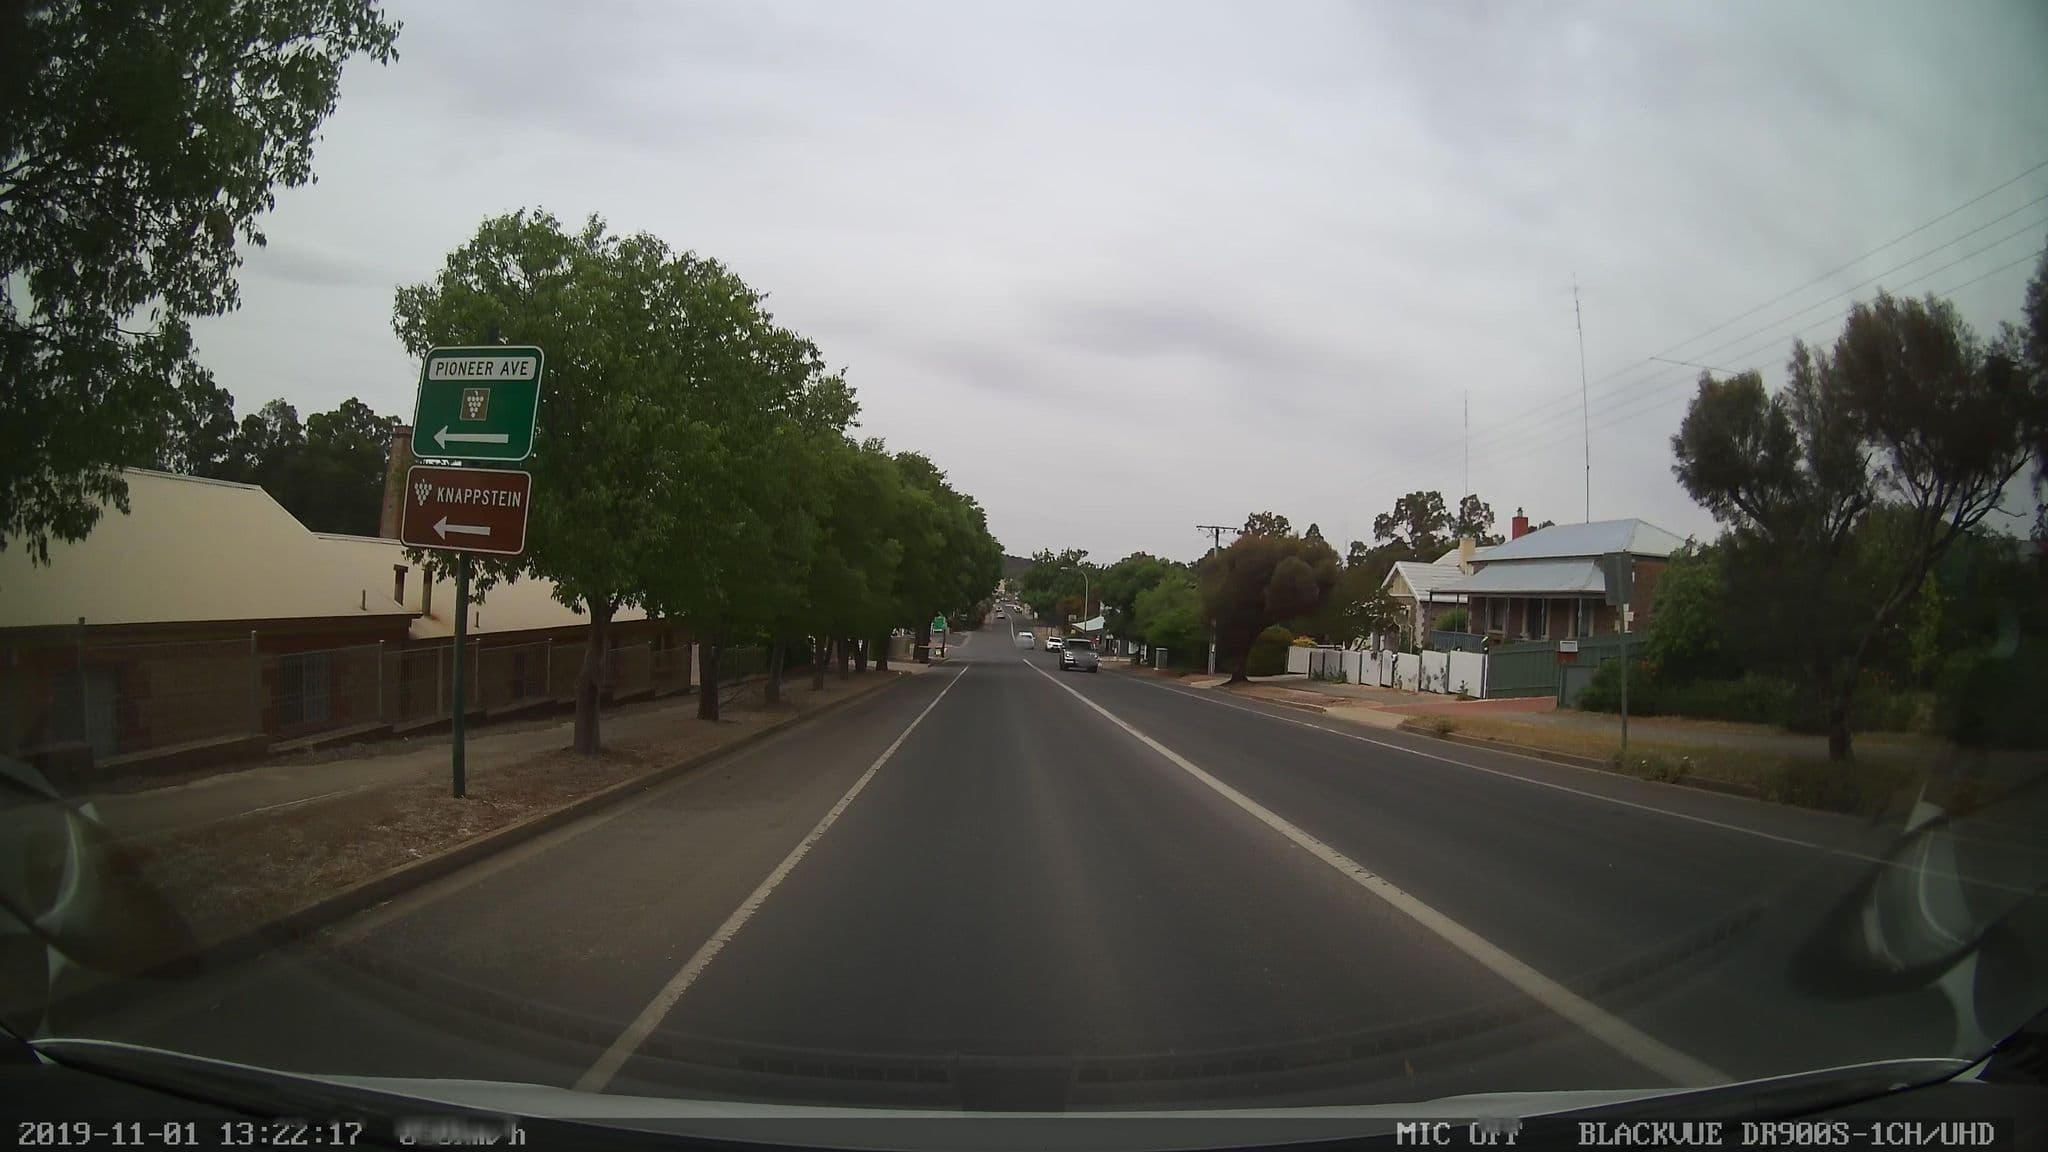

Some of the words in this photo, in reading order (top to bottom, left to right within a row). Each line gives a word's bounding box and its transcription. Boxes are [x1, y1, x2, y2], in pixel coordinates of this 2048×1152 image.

[435, 361, 494, 376] PIONEER
[500, 361, 530, 376] AVE
[437, 487, 521, 507] KNAPPSTEIN
